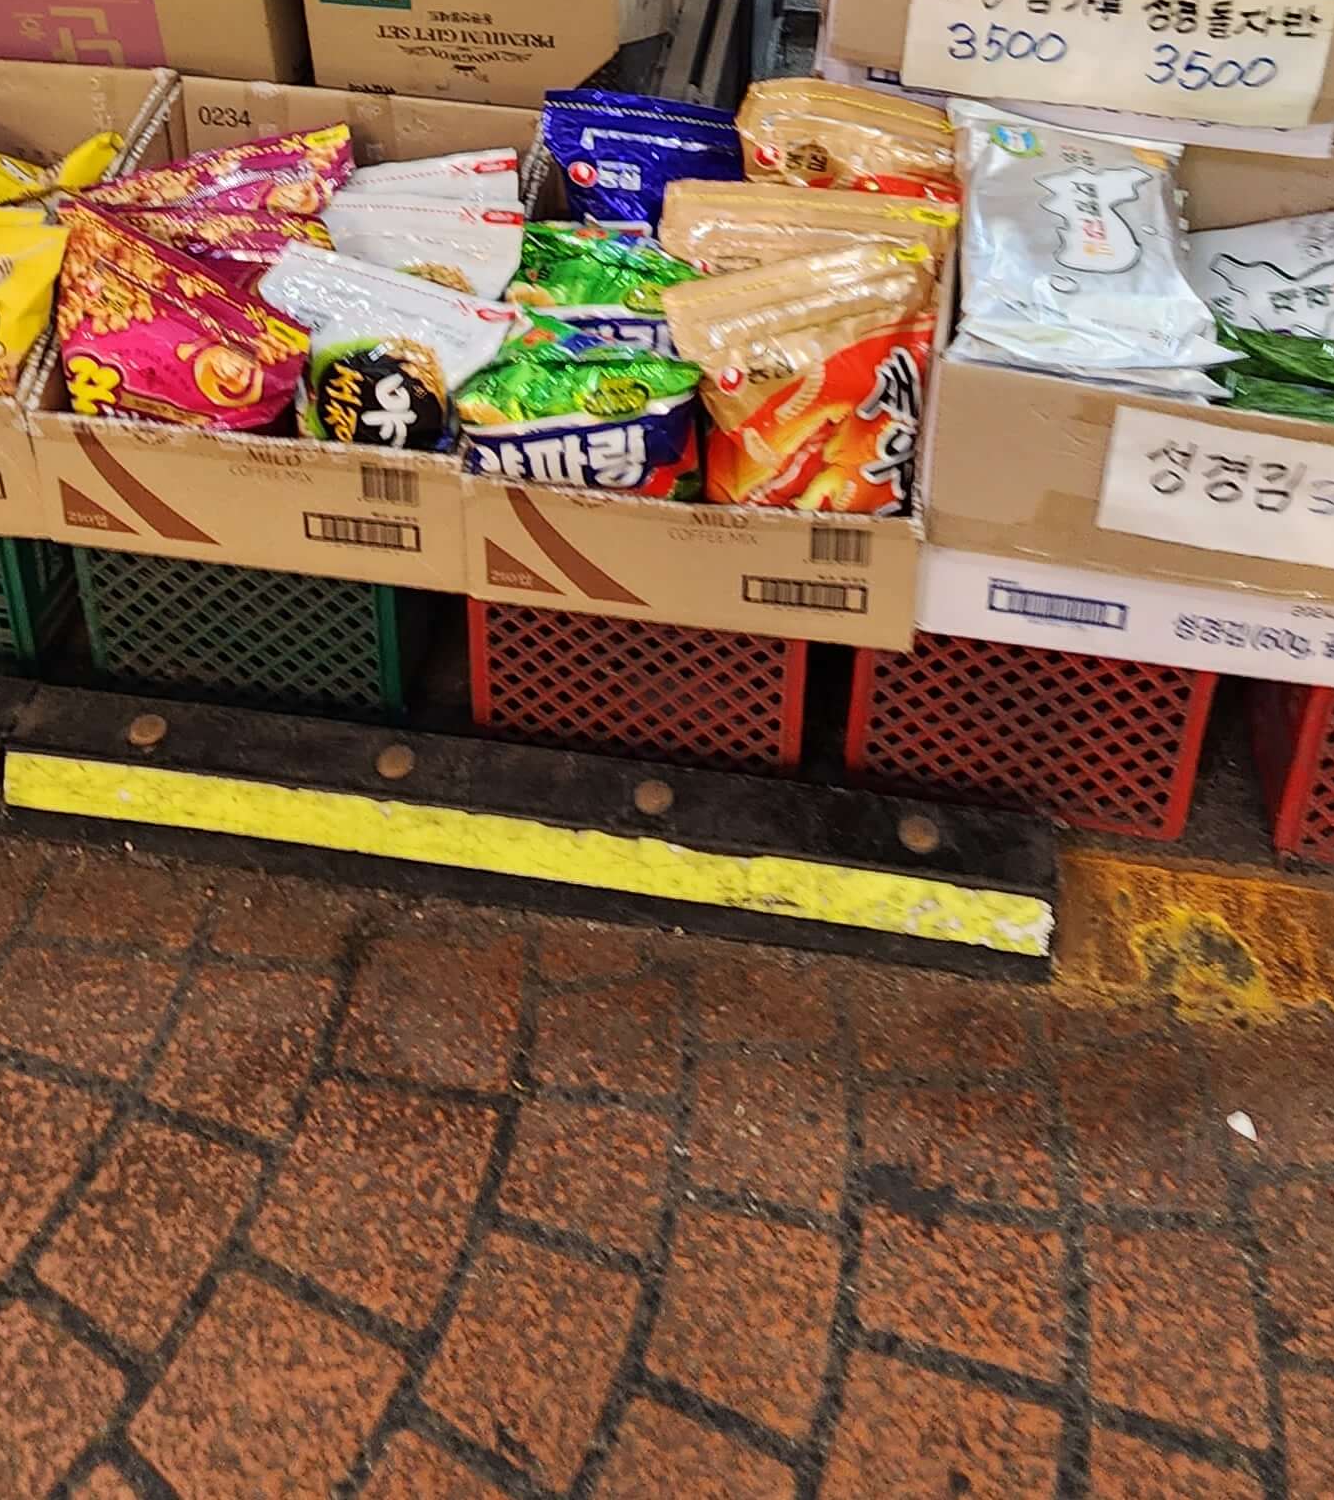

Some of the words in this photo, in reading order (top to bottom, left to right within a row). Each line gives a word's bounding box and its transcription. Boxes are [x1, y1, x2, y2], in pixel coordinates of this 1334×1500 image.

[376, 24, 411, 41] SET
[413, 26, 458, 45] GIFT
[457, 30, 556, 49] PREMIUM
[946, 22, 1068, 63] 3500
[1146, 43, 1279, 91] 3500
[198, 105, 253, 129] 0234
[689, 510, 751, 529] MILD
[668, 529, 725, 545] COFFEE
[726, 531, 759, 547] MIX
